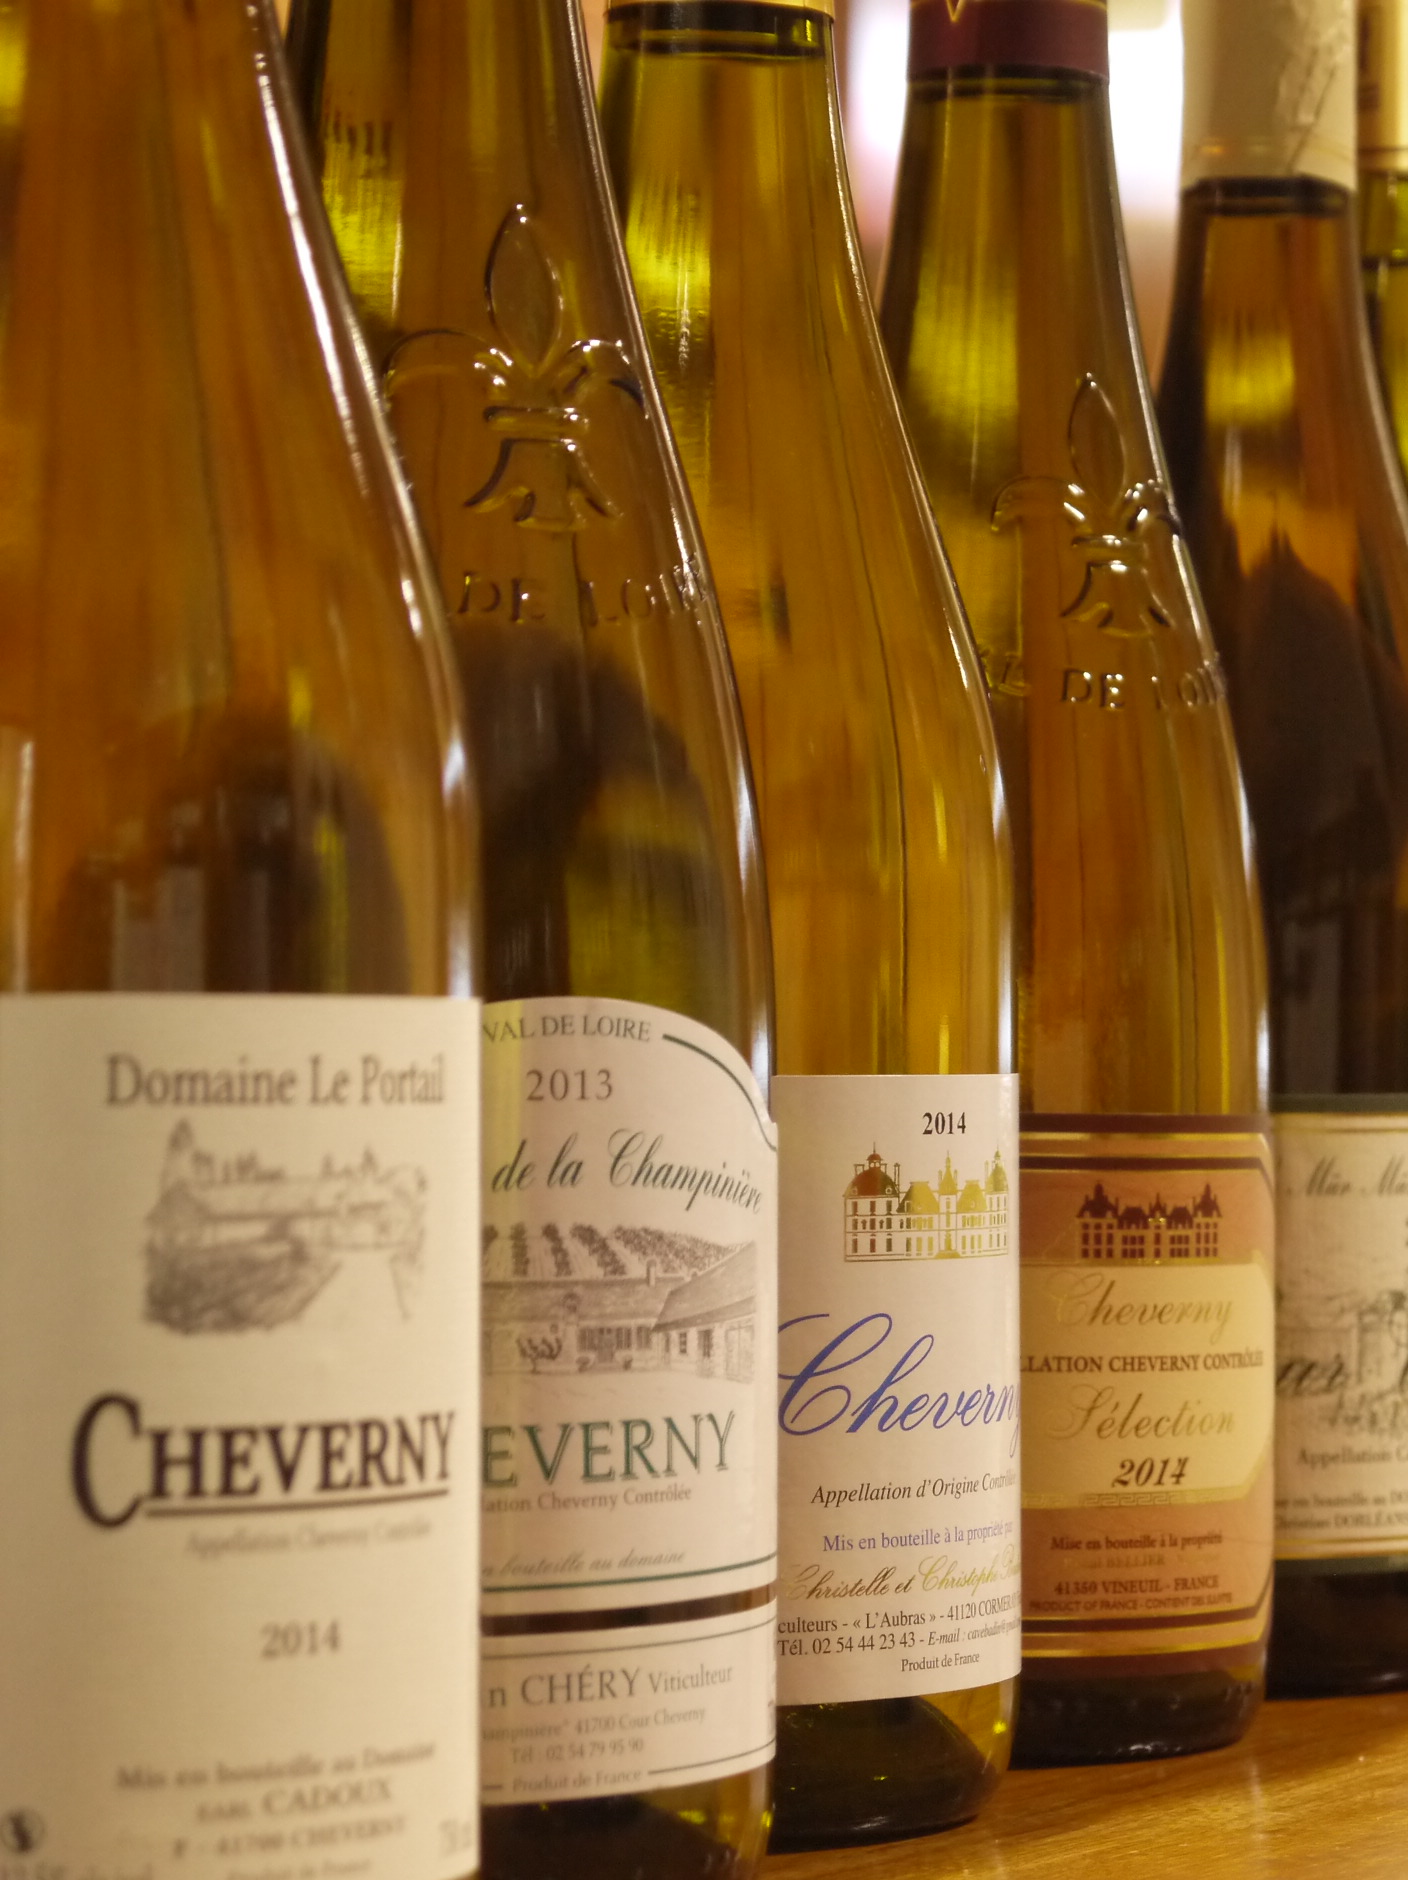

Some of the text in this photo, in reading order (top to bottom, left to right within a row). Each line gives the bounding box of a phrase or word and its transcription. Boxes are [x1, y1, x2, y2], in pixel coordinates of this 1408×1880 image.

[1060, 668, 1126, 711] DE
[483, 1014, 651, 1043] VAL DE LOIRE
[106, 1050, 446, 1107] Domaine Le Portail
[525, 1068, 614, 1102] 2013
[922, 1111, 967, 1135] 2014
[490, 1138, 536, 1194] de
[546, 1131, 584, 1189] la
[1047, 1271, 1233, 1346] Cheverny
[1108, 1354, 1201, 1373] CHEVERNY
[1050, 1382, 1235, 1441] Sélection
[71, 1391, 456, 1530] CHEVERNY
[1111, 1456, 1190, 1488] 2014
[1297, 1447, 1392, 1470] Appellation
[536, 1490, 618, 1512] Cheverny
[622, 1482, 693, 1506] Contrôlée
[811, 1481, 912, 1508] Appellation
[915, 1477, 980, 1500] d'Origine
[822, 1535, 854, 1552] Mis
[858, 1535, 877, 1550] en
[881, 1527, 941, 1549] bouteille
[943, 1527, 952, 1543] à
[953, 1526, 965, 1543] la
[1050, 1535, 1083, 1551] Mise
[1085, 1538, 1102, 1550] en
[1104, 1534, 1158, 1550] bouteille
[1168, 1532, 1178, 1548] la
[893, 1574, 917, 1595] et
[1101, 1578, 1163, 1595] VINEUIL
[1173, 1575, 1220, 1592] FRANCE
[947, 1602, 976, 1622] 41120
[259, 1616, 343, 1661] 2014
[778, 1640, 808, 1656] Tél.
[812, 1638, 831, 1655] 02
[836, 1637, 854, 1653] 54
[857, 1634, 875, 1652] 44
[879, 1633, 896, 1650] 23
[899, 1631, 916, 1648] 43
[927, 1628, 961, 1646] E-mail
[901, 1651, 981, 1672] Produit de France
[521, 1663, 642, 1707] CHÉRY
[647, 1663, 734, 1694] Viticulteur
[574, 1714, 616, 1735] 41700
[618, 1712, 651, 1731] Cour
[653, 1706, 706, 1728] Cheverny
[512, 1769, 643, 1793] Produit de France
[261, 1775, 394, 1819] CADOUX
